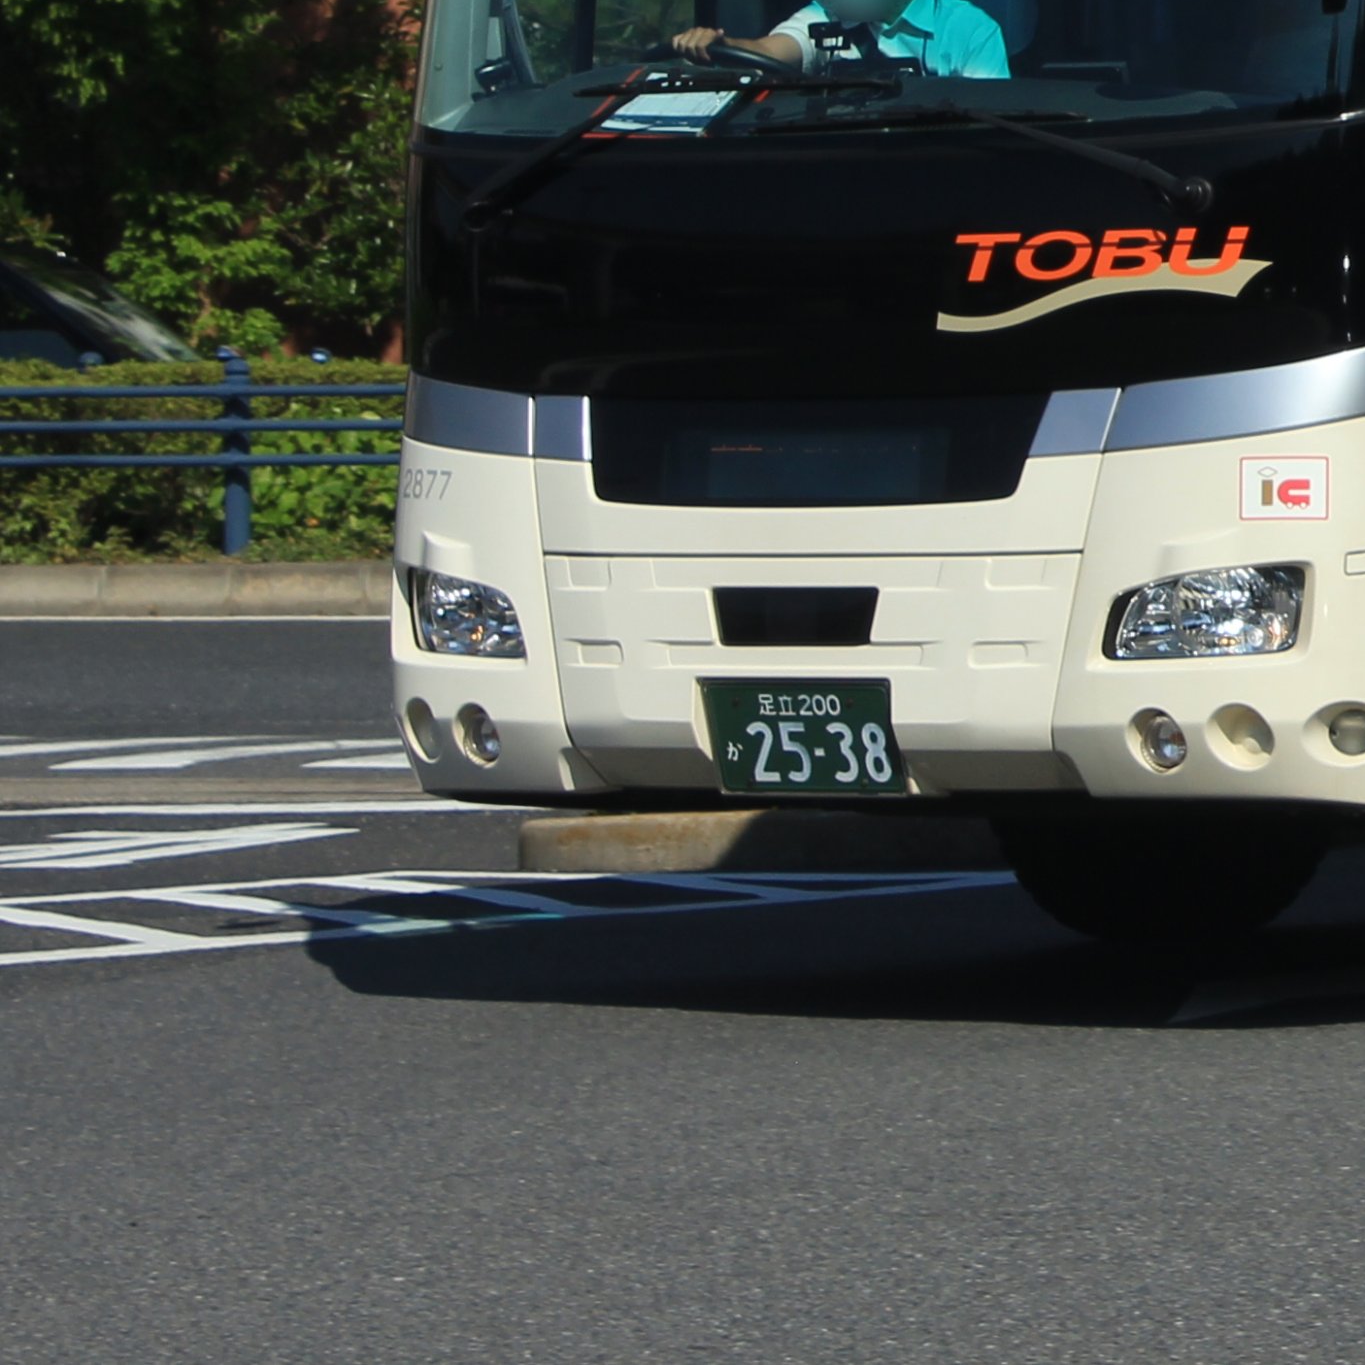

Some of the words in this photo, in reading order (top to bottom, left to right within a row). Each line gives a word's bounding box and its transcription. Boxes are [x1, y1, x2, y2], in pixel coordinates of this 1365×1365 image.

[955, 225, 1250, 283] TOBU
[403, 468, 453, 501] 2877
[758, 693, 842, 717] 足立200
[726, 741, 744, 762] か
[746, 721, 893, 783] 25-38
